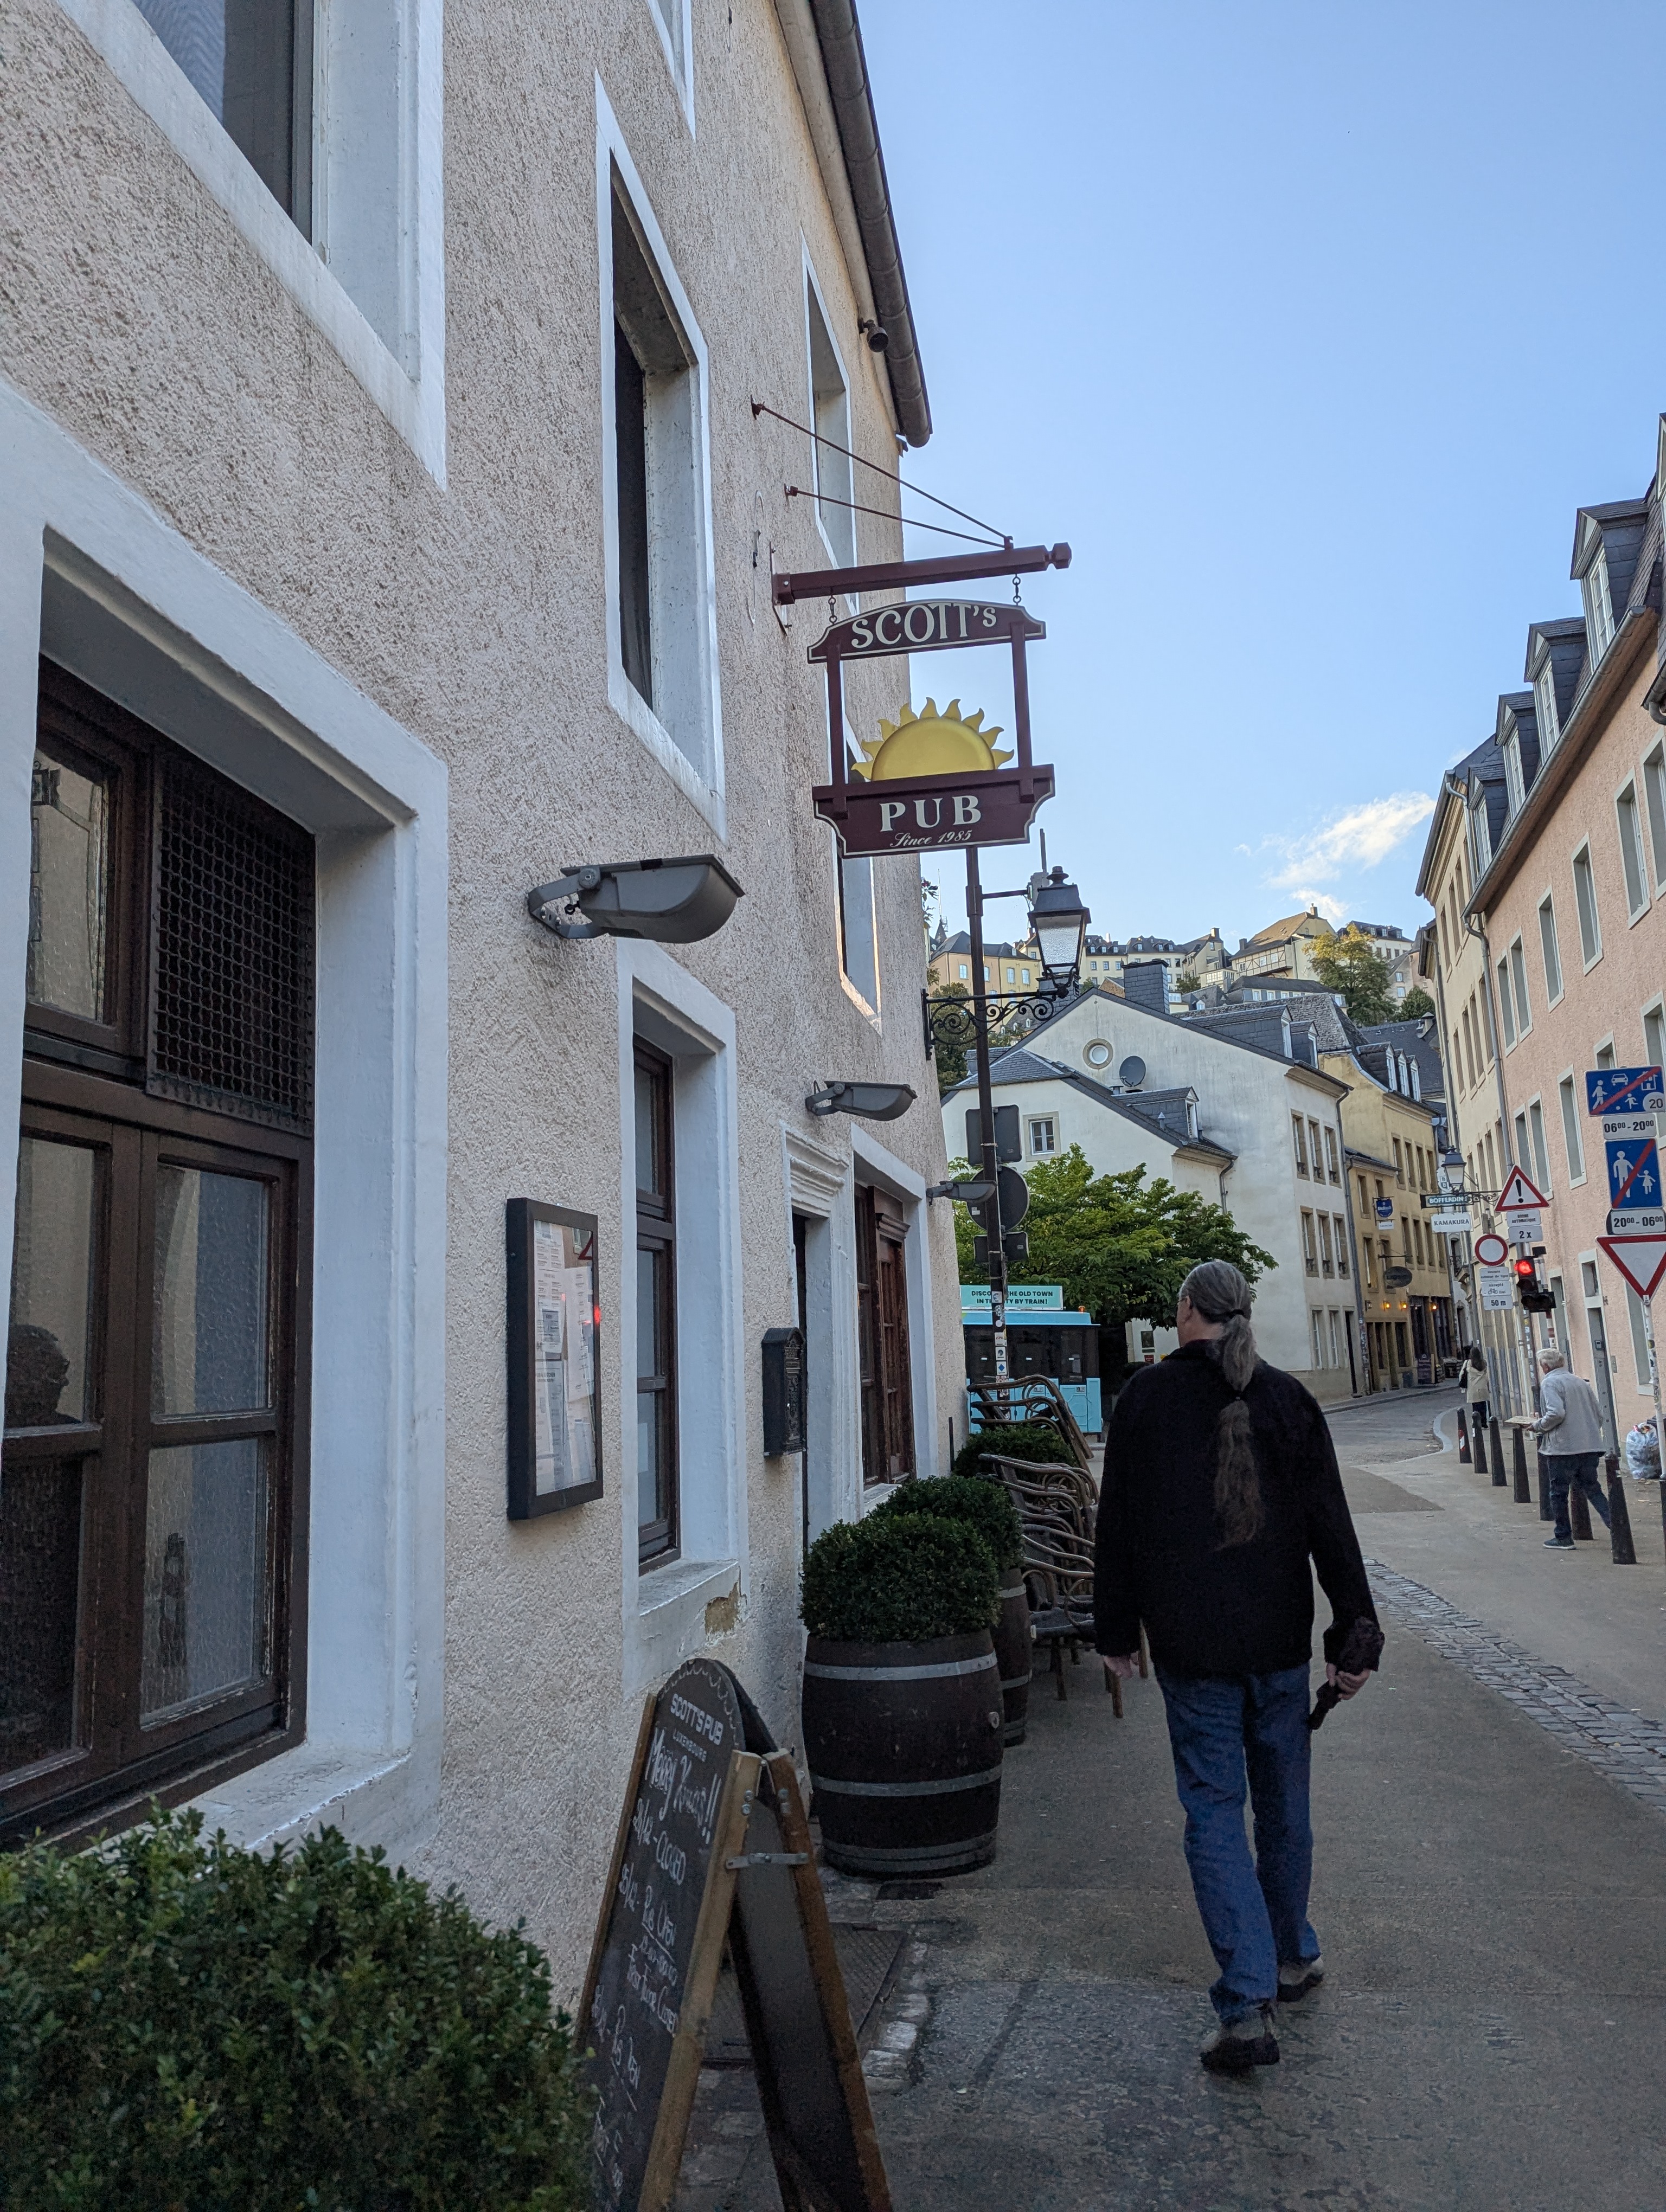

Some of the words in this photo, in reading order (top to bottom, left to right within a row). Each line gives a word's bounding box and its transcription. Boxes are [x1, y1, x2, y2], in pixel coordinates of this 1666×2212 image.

[879, 794, 982, 832] PUB
[889, 832, 932, 847] Since
[937, 829, 973, 844] 1985
[1648, 1098, 1664, 1109] 20
[1519, 1231, 1525, 1239] 2
[702, 1714, 724, 1746] PUB
